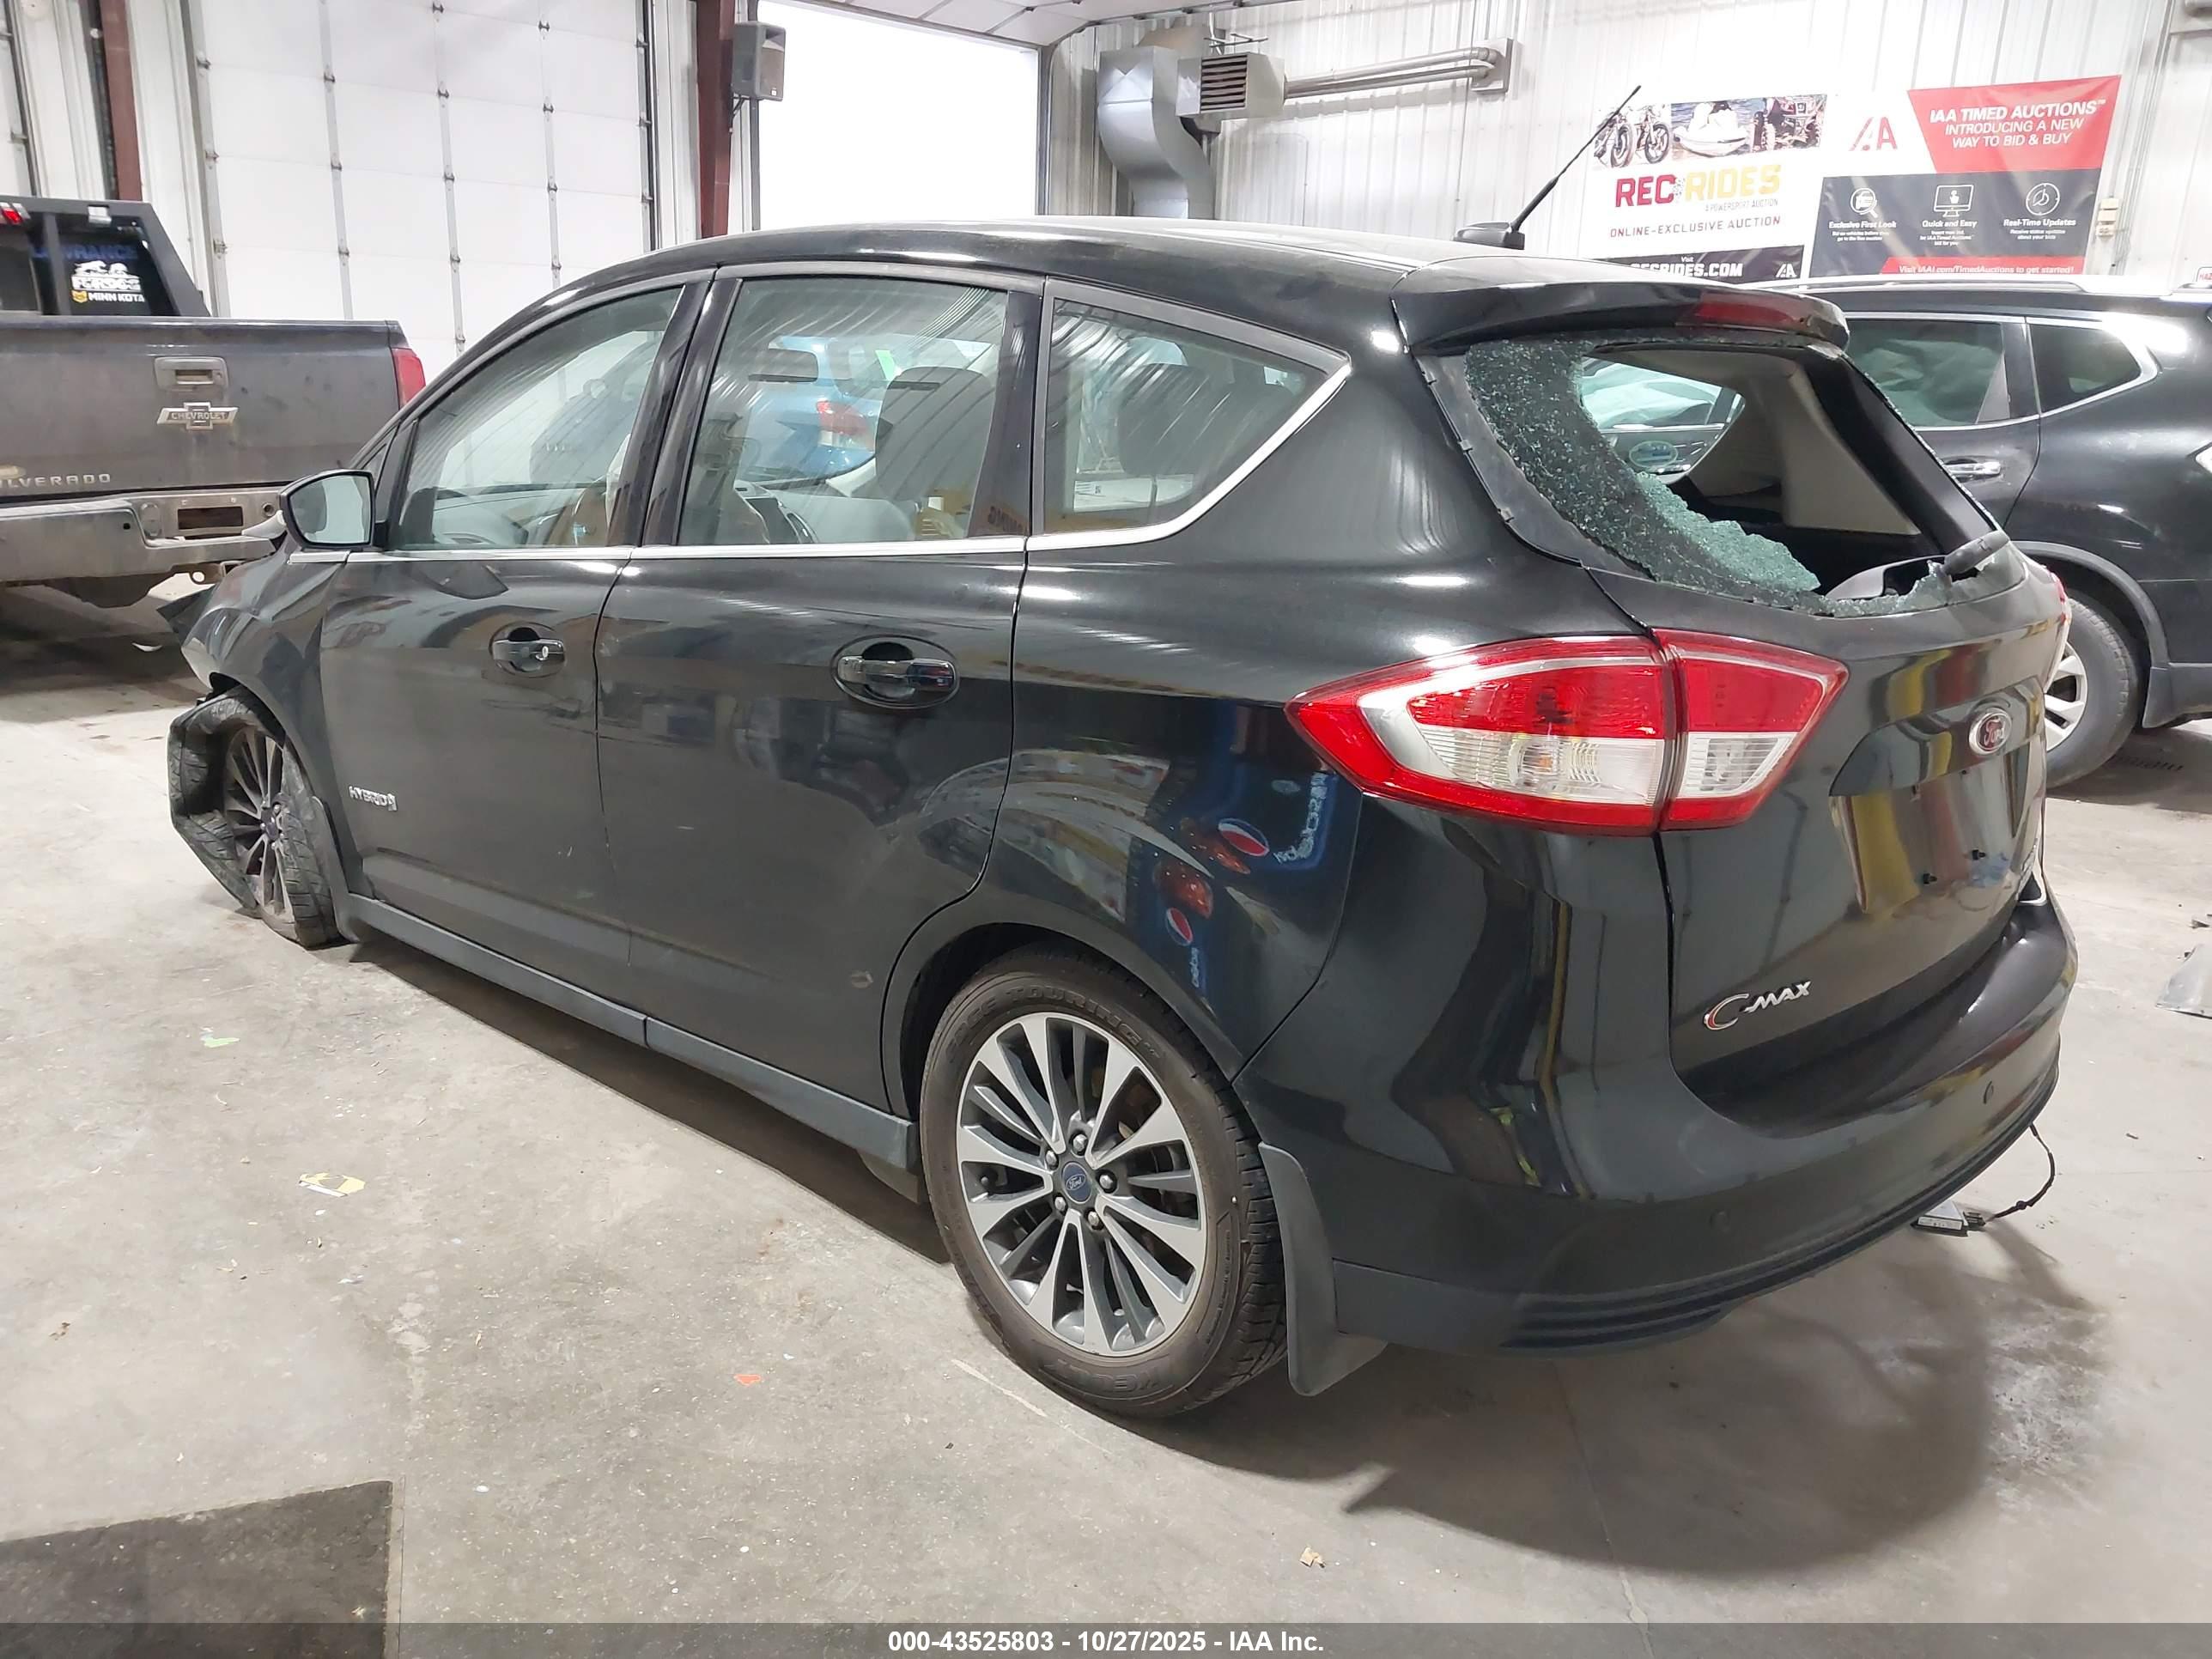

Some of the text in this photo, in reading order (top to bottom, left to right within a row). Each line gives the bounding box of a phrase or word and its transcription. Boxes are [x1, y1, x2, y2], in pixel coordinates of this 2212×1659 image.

[1929, 107, 1957, 124] IAA
[1960, 106, 2007, 121] TIMED
[1945, 118, 2085, 135] INTRODUCING A NEW
[1953, 132, 2073, 149] WAY TO BID & BUY
[1615, 165, 1781, 207] REC RIDES
[1752, 198, 1778, 208] AUCTION
[1610, 216, 1782, 238] ONLINE-EXCLUSIVE AUCTION
[1829, 221, 1860, 229] Exclusive
[1960, 219, 1978, 228] Easy
[2043, 218, 2076, 227] Updates
[1632, 263, 1743, 277] RIDES.COM
[2026, 265, 2040, 274] get
[2041, 265, 2075, 274] started!
[88, 292, 145, 302] MINN KOTA
[171, 410, 228, 422] CHEVROLET
[0, 473, 111, 489] ILVERADO
